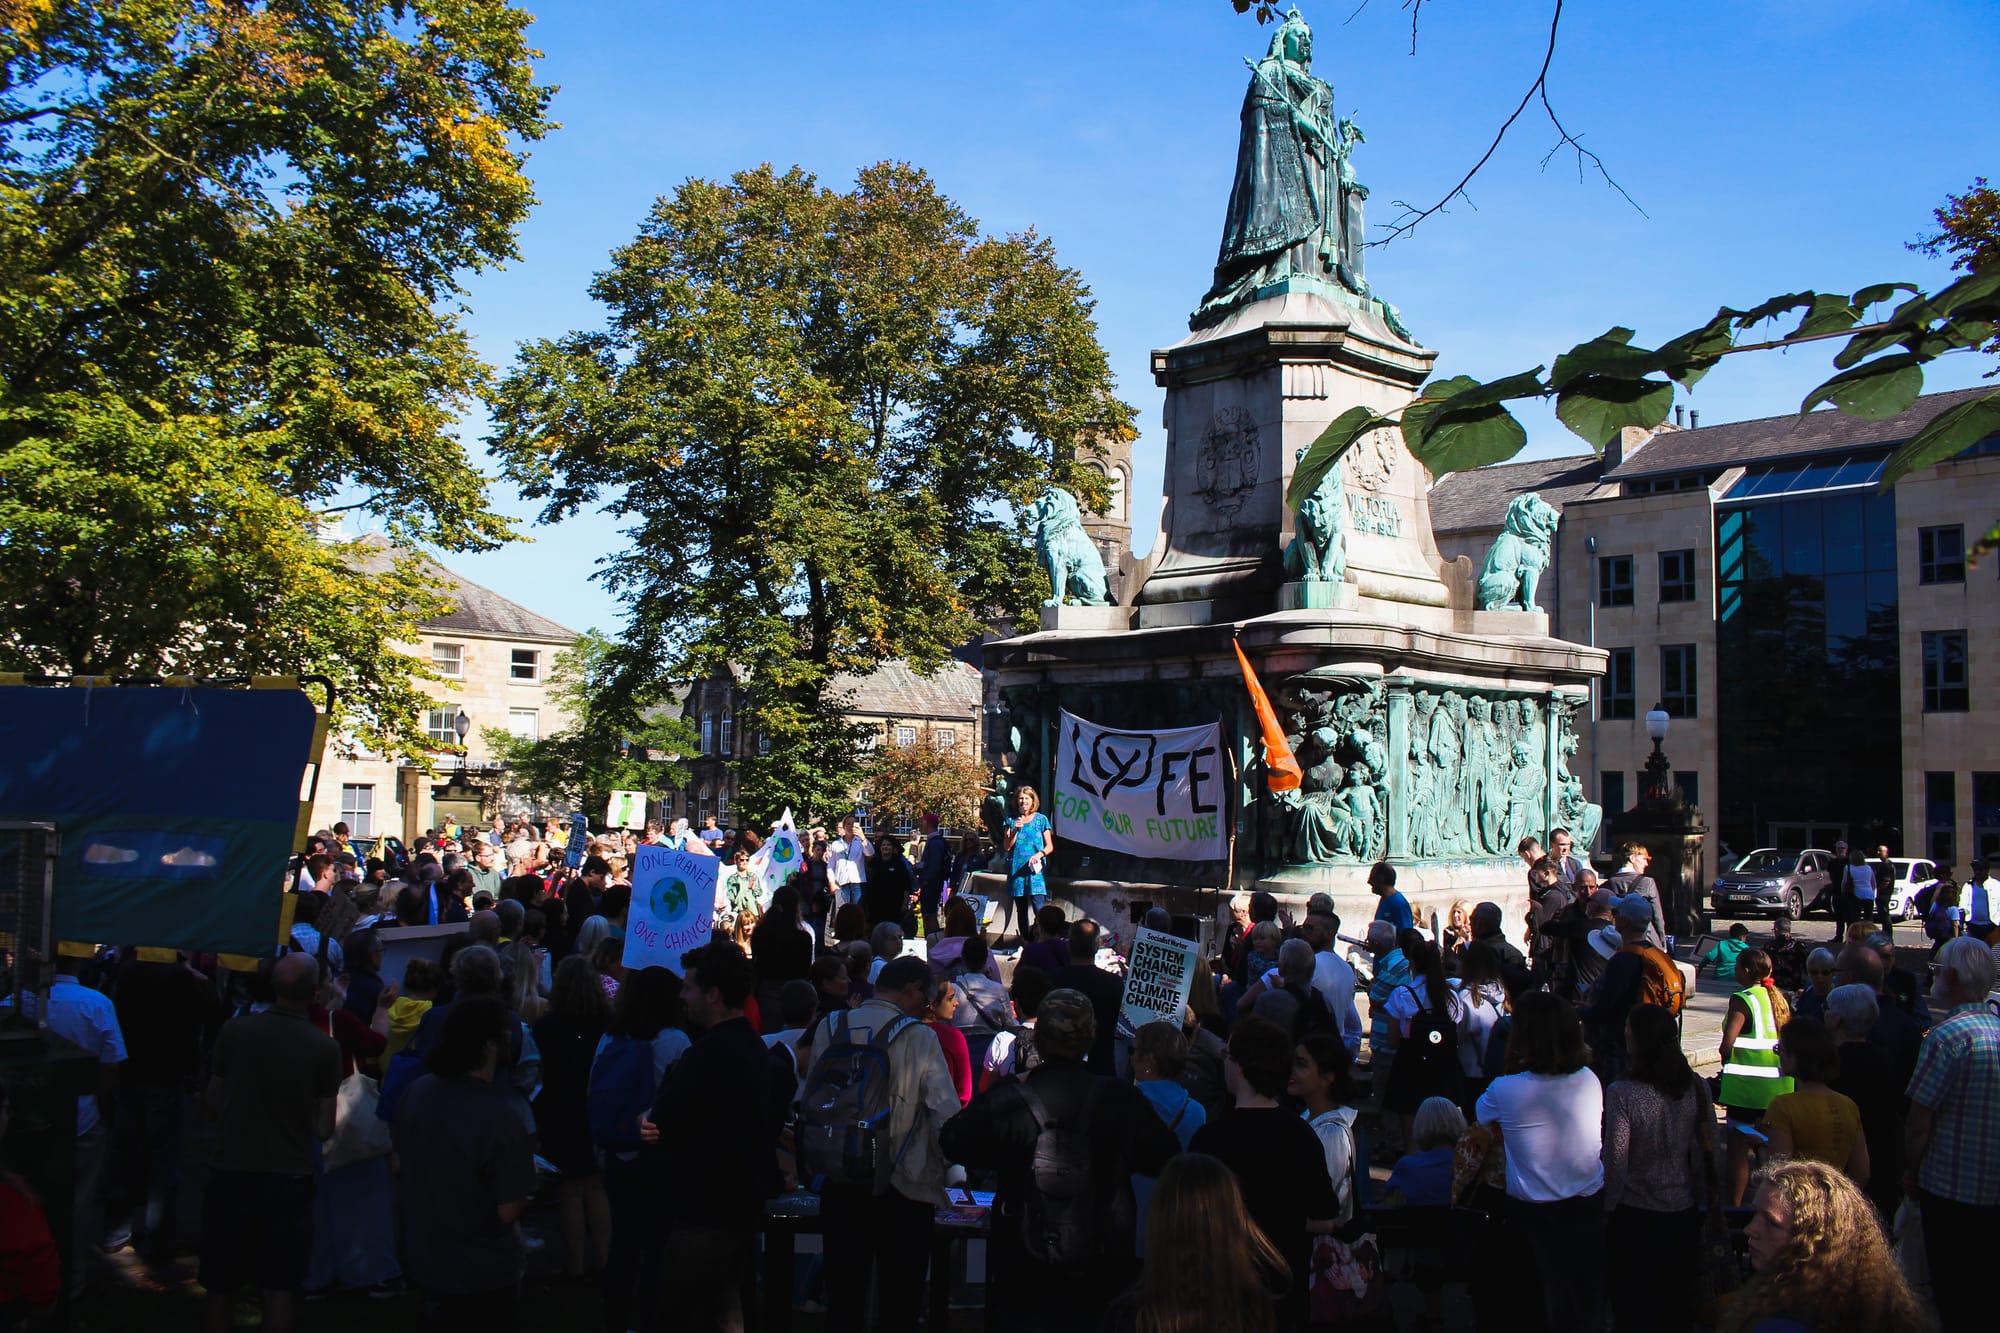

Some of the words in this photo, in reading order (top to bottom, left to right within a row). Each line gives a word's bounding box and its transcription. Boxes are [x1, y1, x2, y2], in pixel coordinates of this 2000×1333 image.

[1345, 492, 1402, 521] VICTORIA
[1053, 790, 1091, 823] FOR
[1102, 809, 1134, 836] OUR
[1146, 816, 1218, 842] FUTURE
[641, 851, 671, 871] ONE
[675, 853, 714, 890] PLANET
[633, 920, 659, 947] ONE
[664, 913, 714, 951] CHANCE
[1146, 932, 1170, 945] Socialist
[1135, 941, 1185, 966] SYSTEM
[1131, 967, 1158, 984] NOT
[1133, 954, 1185, 979] CHANGE
[1126, 992, 1178, 1015] CHANGE
[1128, 979, 1181, 1004] CLIMATE
